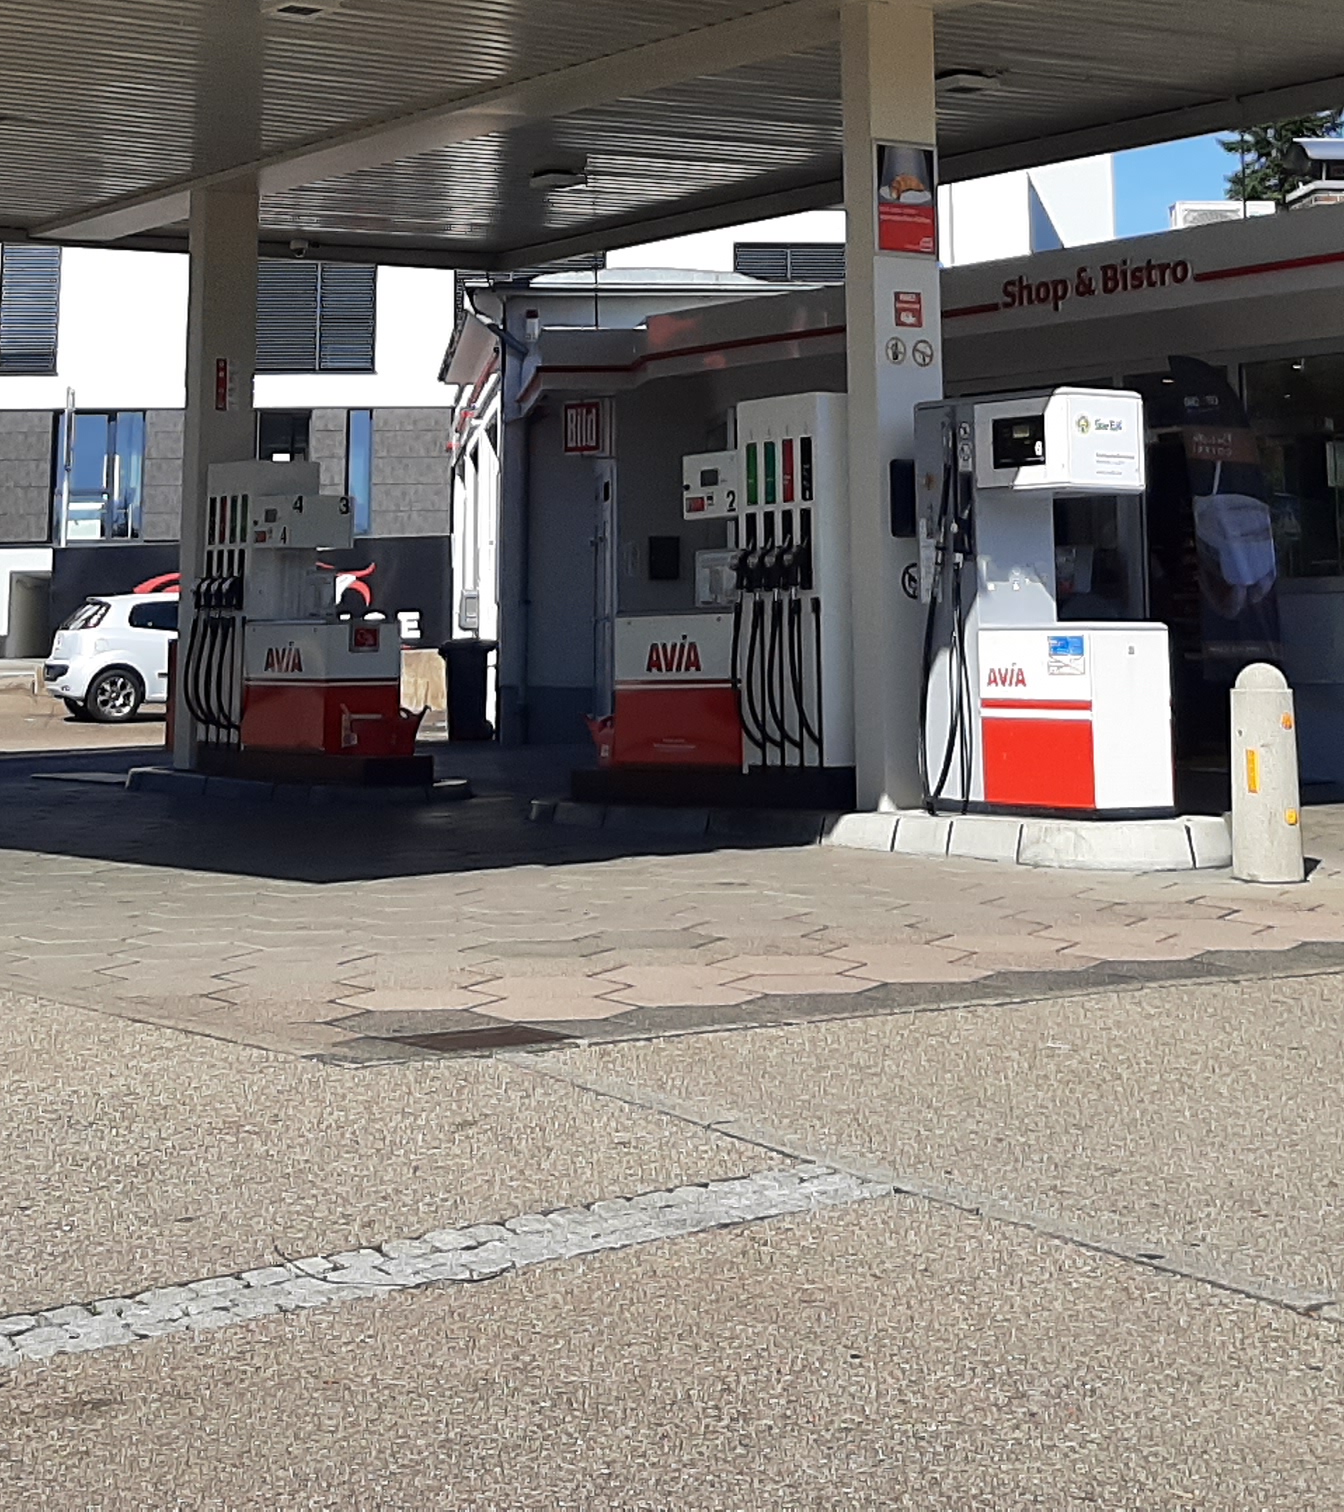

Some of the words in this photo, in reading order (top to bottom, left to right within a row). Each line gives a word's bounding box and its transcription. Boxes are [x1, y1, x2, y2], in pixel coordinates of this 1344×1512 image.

[1002, 275, 1070, 312] Shop
[1075, 266, 1096, 297] &
[1100, 259, 1191, 295] Bistro
[292, 495, 304, 514] 4
[339, 496, 350, 515] 3
[726, 489, 737, 513] 2
[279, 526, 288, 545] 4
[264, 641, 303, 673] AVIA
[646, 635, 702, 672] AVIA
[987, 662, 1027, 687] AVIA
